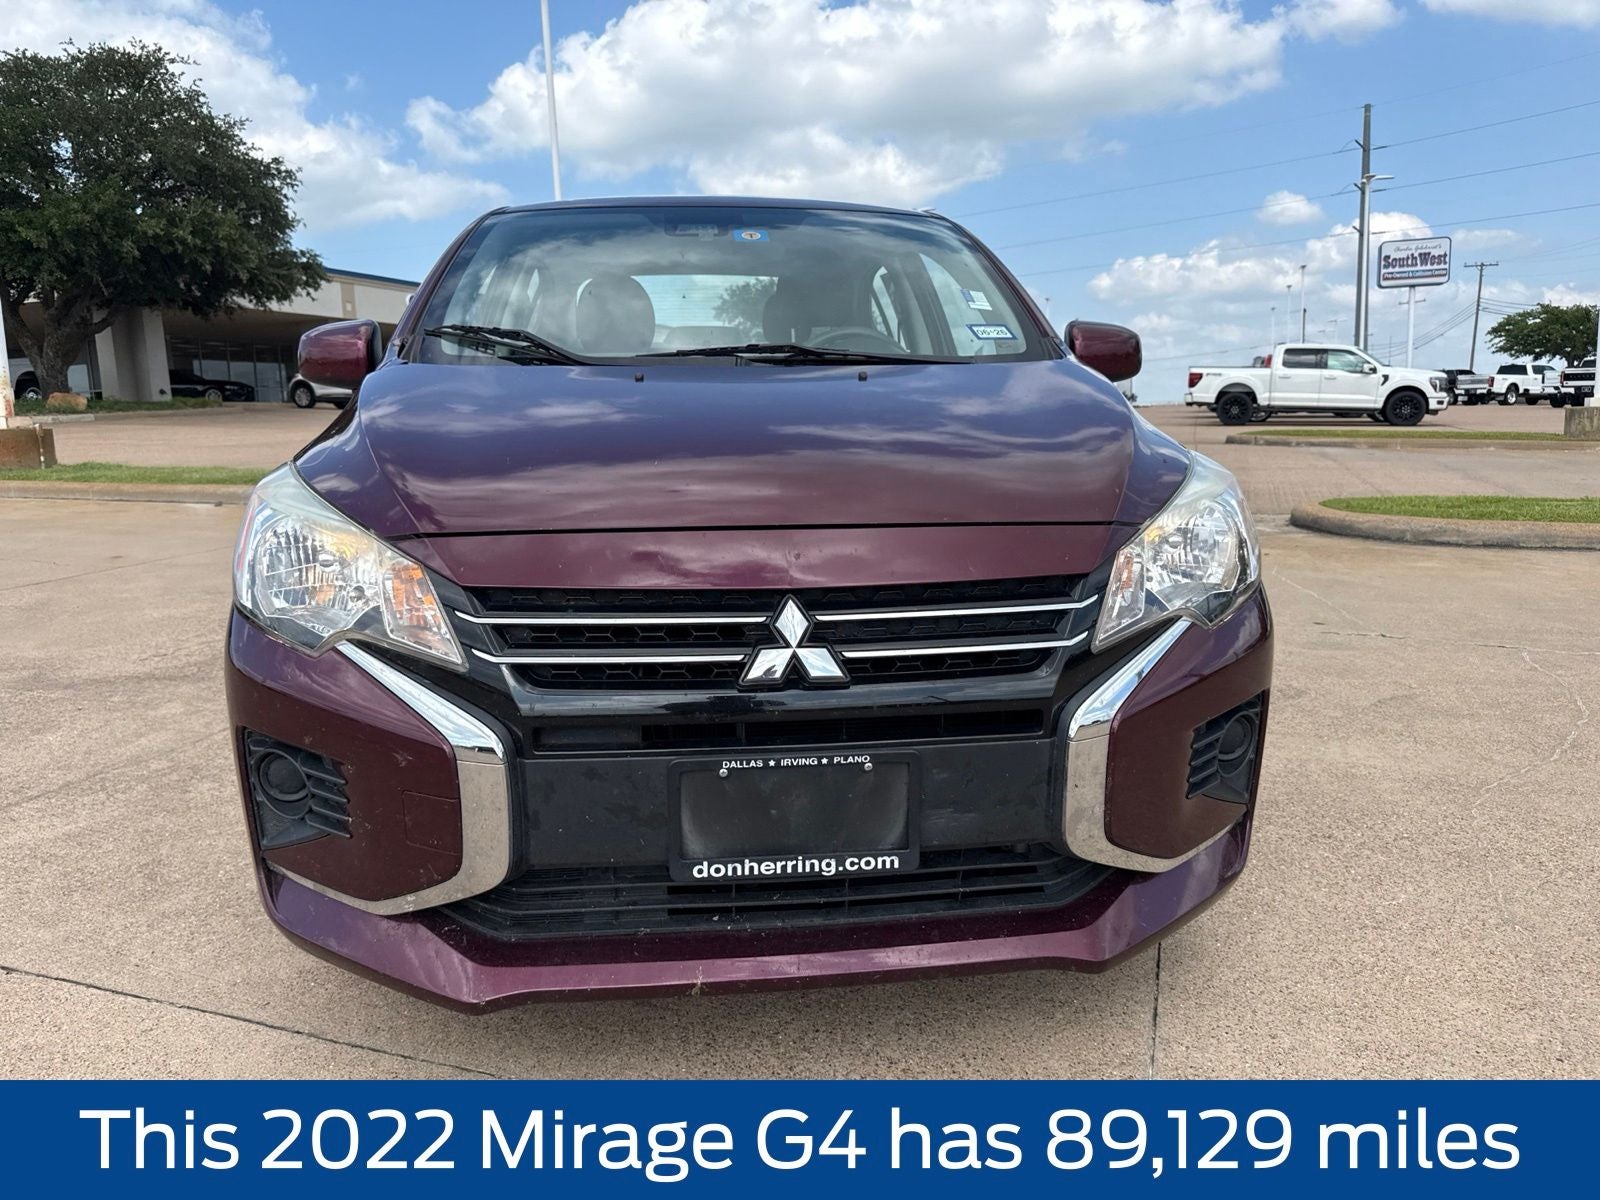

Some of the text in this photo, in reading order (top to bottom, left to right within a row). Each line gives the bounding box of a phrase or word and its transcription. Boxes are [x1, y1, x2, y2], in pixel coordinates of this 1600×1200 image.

[1382, 251, 1448, 270] SouthWest
[722, 755, 871, 770] DALLAS IRVING PLANO
[692, 855, 900, 879] donherring.com
